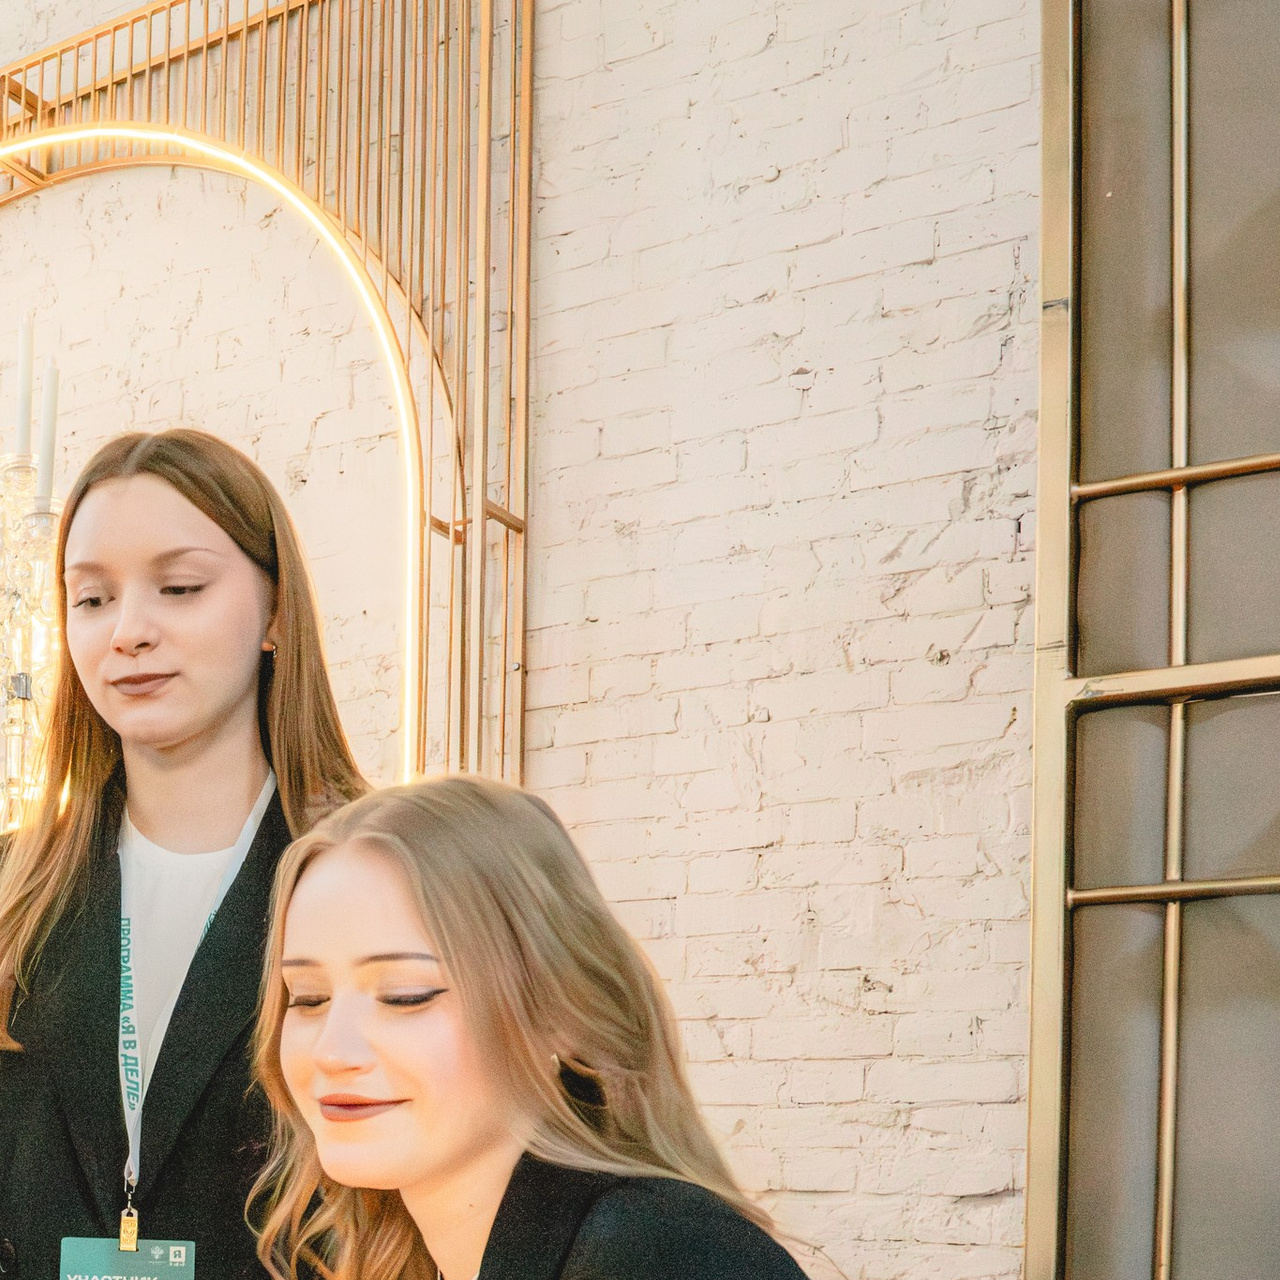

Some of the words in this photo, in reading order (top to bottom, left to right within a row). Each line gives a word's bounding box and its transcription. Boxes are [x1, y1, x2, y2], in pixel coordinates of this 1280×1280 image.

[120, 917, 134, 1013] ПРОГРАММА
[122, 1040, 137, 1050] В
[121, 1053, 139, 1111] ДЕЛЕ»
